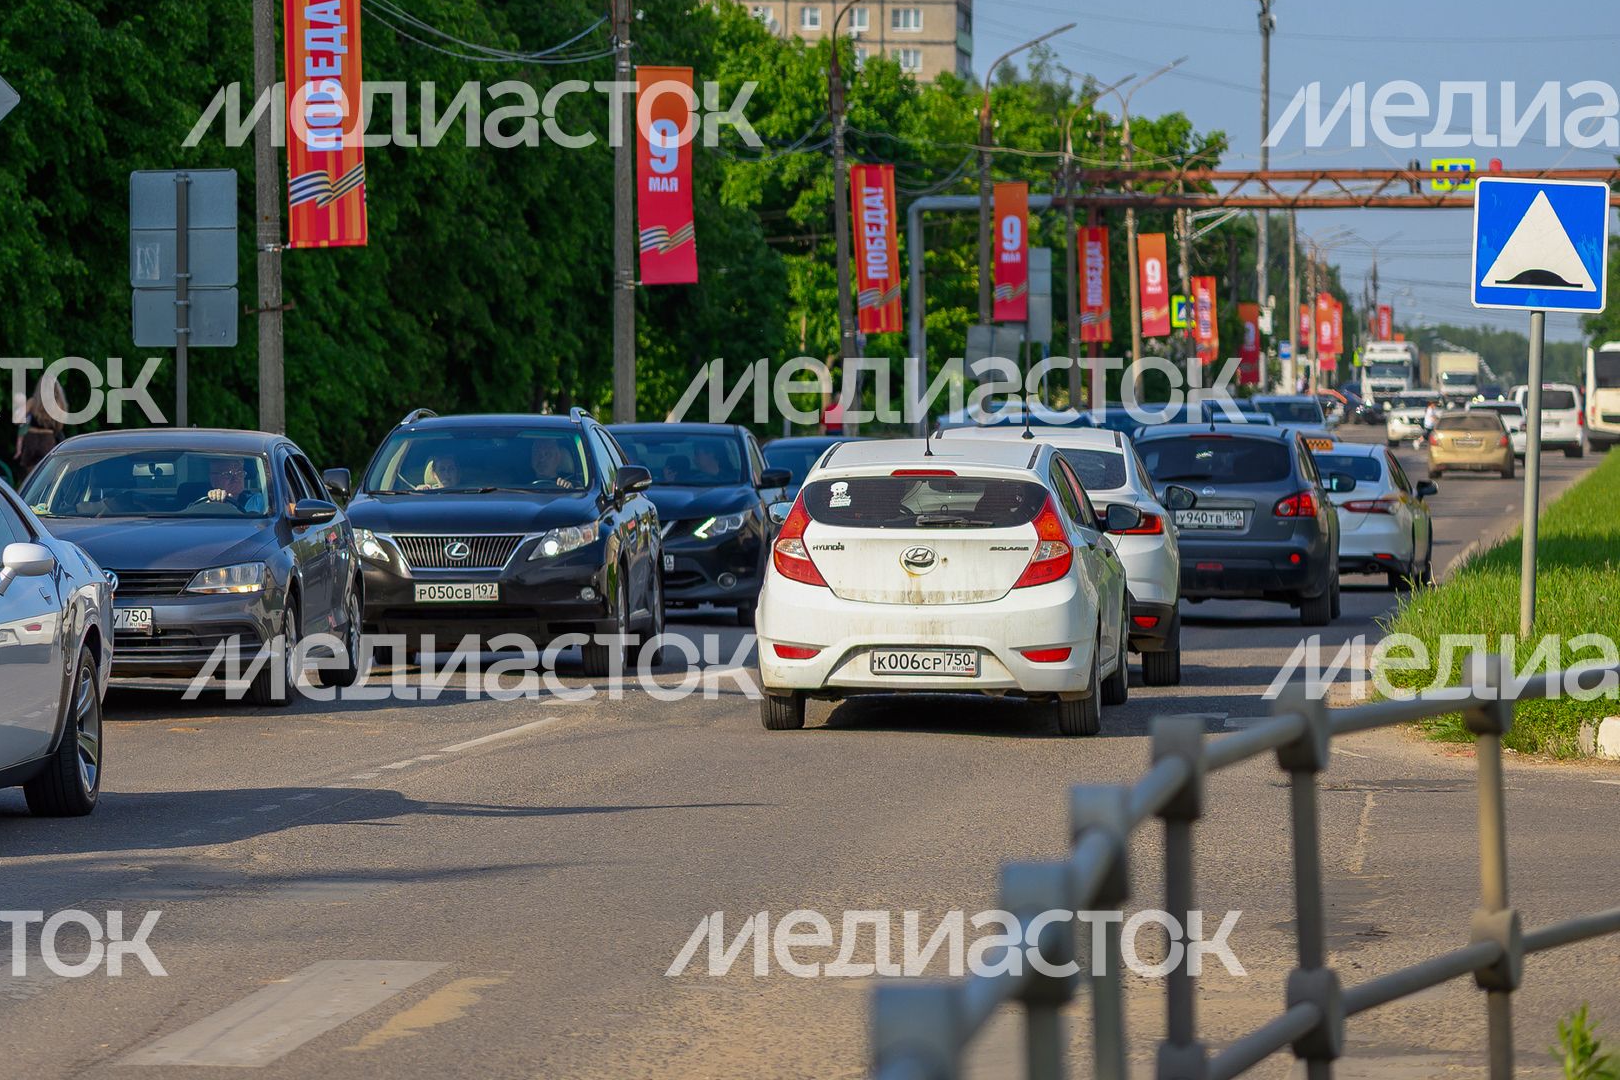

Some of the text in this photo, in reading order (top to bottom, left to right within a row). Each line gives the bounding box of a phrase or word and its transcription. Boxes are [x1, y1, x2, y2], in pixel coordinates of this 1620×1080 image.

[648, 118, 680, 175] 9
[648, 176, 679, 193] МАЯ
[862, 186, 889, 280] ПОБЕДА!
[1001, 215, 1022, 251] 9
[1145, 257, 1162, 284] 9
[419, 584, 495, 600] Р050СВ 197
[123, 610, 148, 623] 750
[877, 653, 972, 671] К006СР 750
